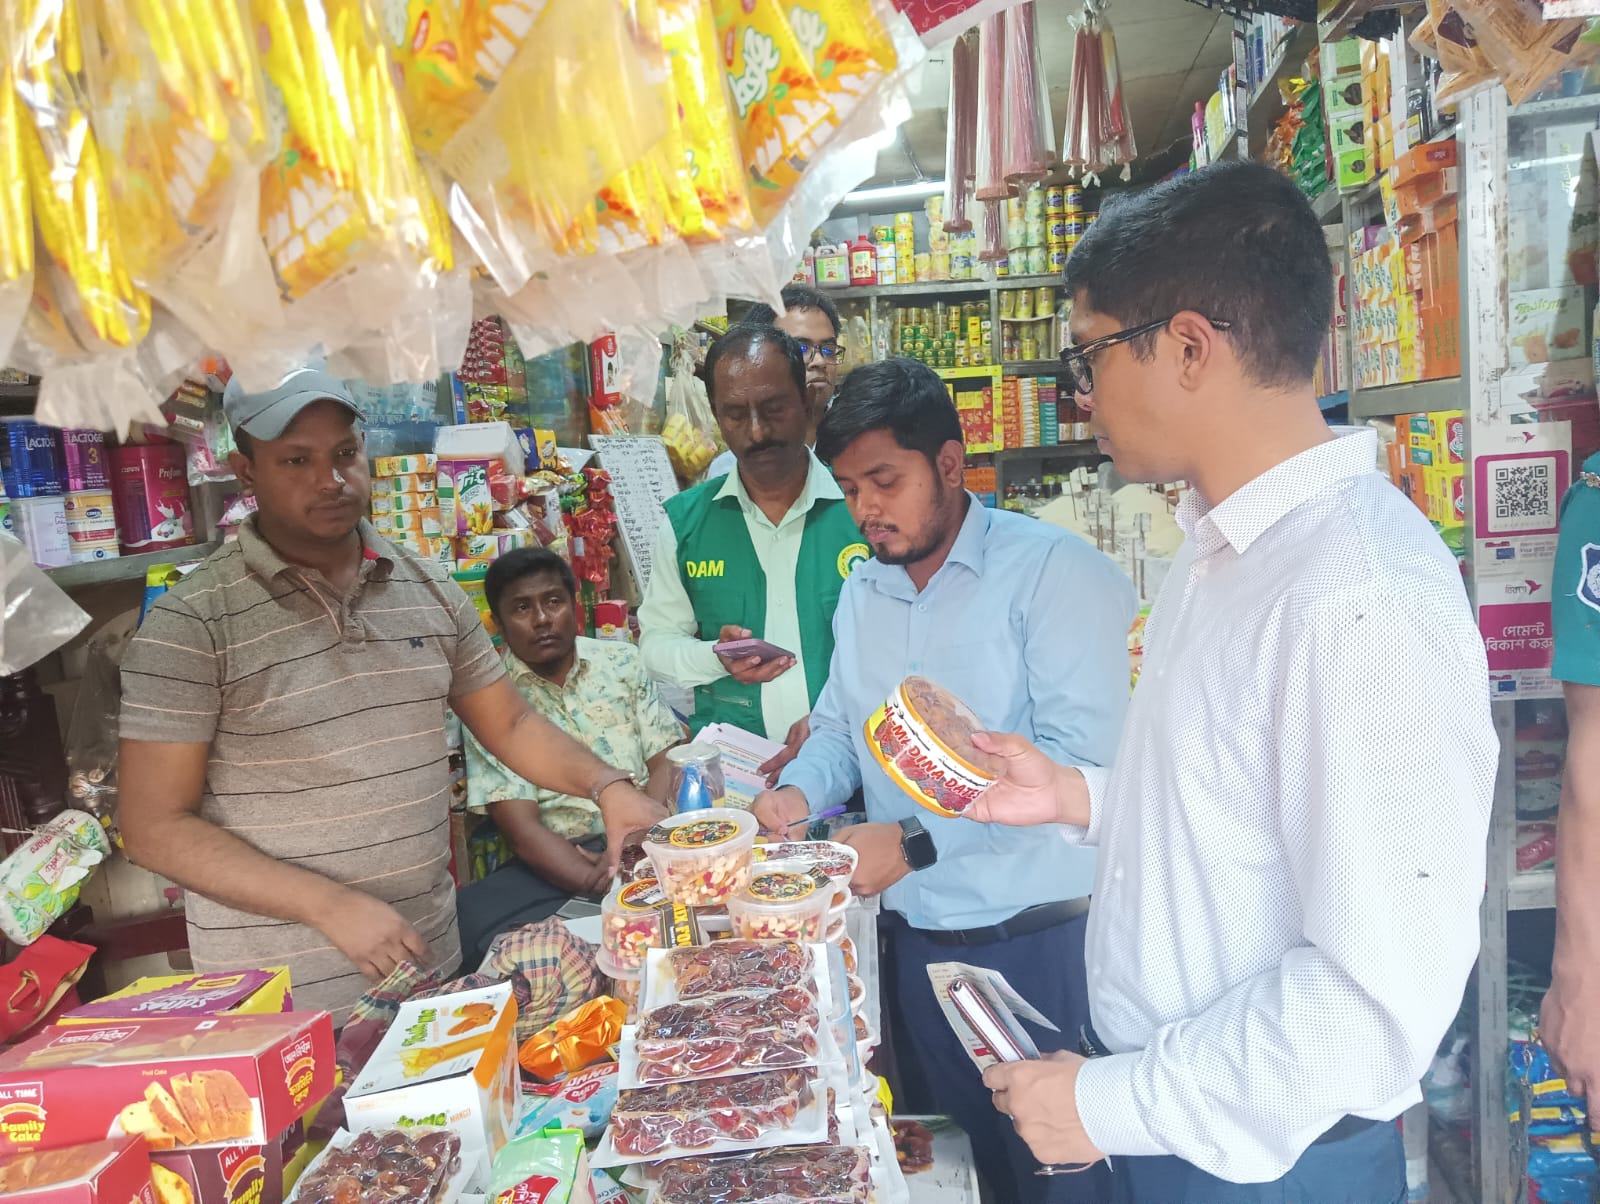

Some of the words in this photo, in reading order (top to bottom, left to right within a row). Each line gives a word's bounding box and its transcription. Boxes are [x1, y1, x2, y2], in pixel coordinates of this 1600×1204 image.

[67, 433, 104, 445] LACTOGE
[88, 447, 98, 464] 3
[686, 560, 725, 578] DAM
[1502, 622, 1545, 638] পেমেন্ট
[1485, 637, 1524, 651] বিকাশ
[1528, 637, 1553, 650] করু
[944, 778, 984, 800] DATES
[566, 1066, 614, 1087] DANO
[15, 1088, 38, 1098] TIME
[1, 1120, 46, 1133] Family
[9, 1130, 42, 1143] Cake
[225, 1153, 239, 1168] ALL
